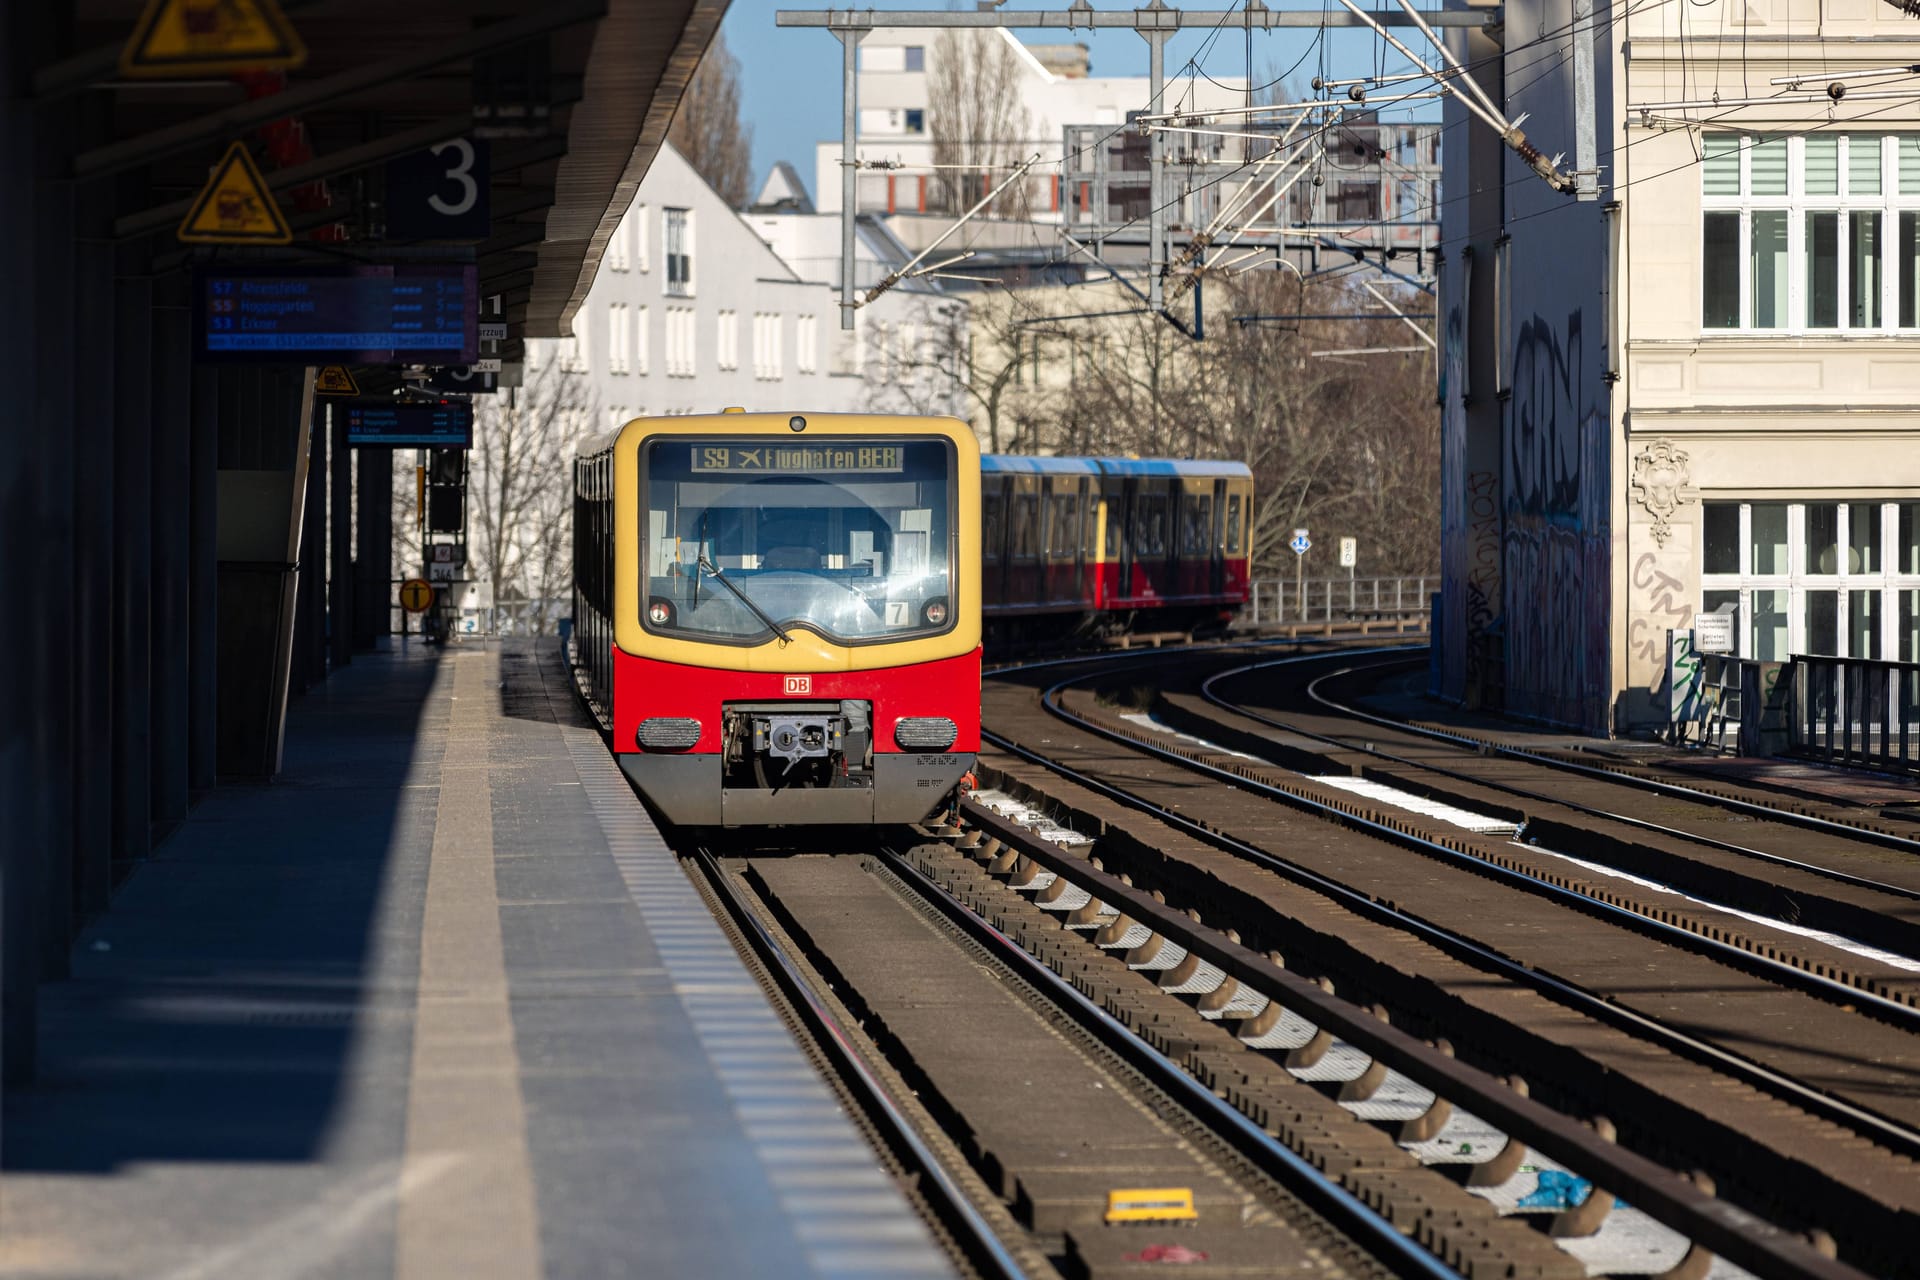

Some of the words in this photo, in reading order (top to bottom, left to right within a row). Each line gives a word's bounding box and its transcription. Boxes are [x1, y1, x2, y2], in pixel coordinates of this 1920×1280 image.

[427, 137, 479, 217] 3
[213, 299, 233, 312] S5
[704, 447, 729, 468] S9
[765, 448, 854, 469] Flughafen
[858, 447, 896, 468] BER
[891, 603, 904, 625] 7
[787, 678, 808, 692] DB
